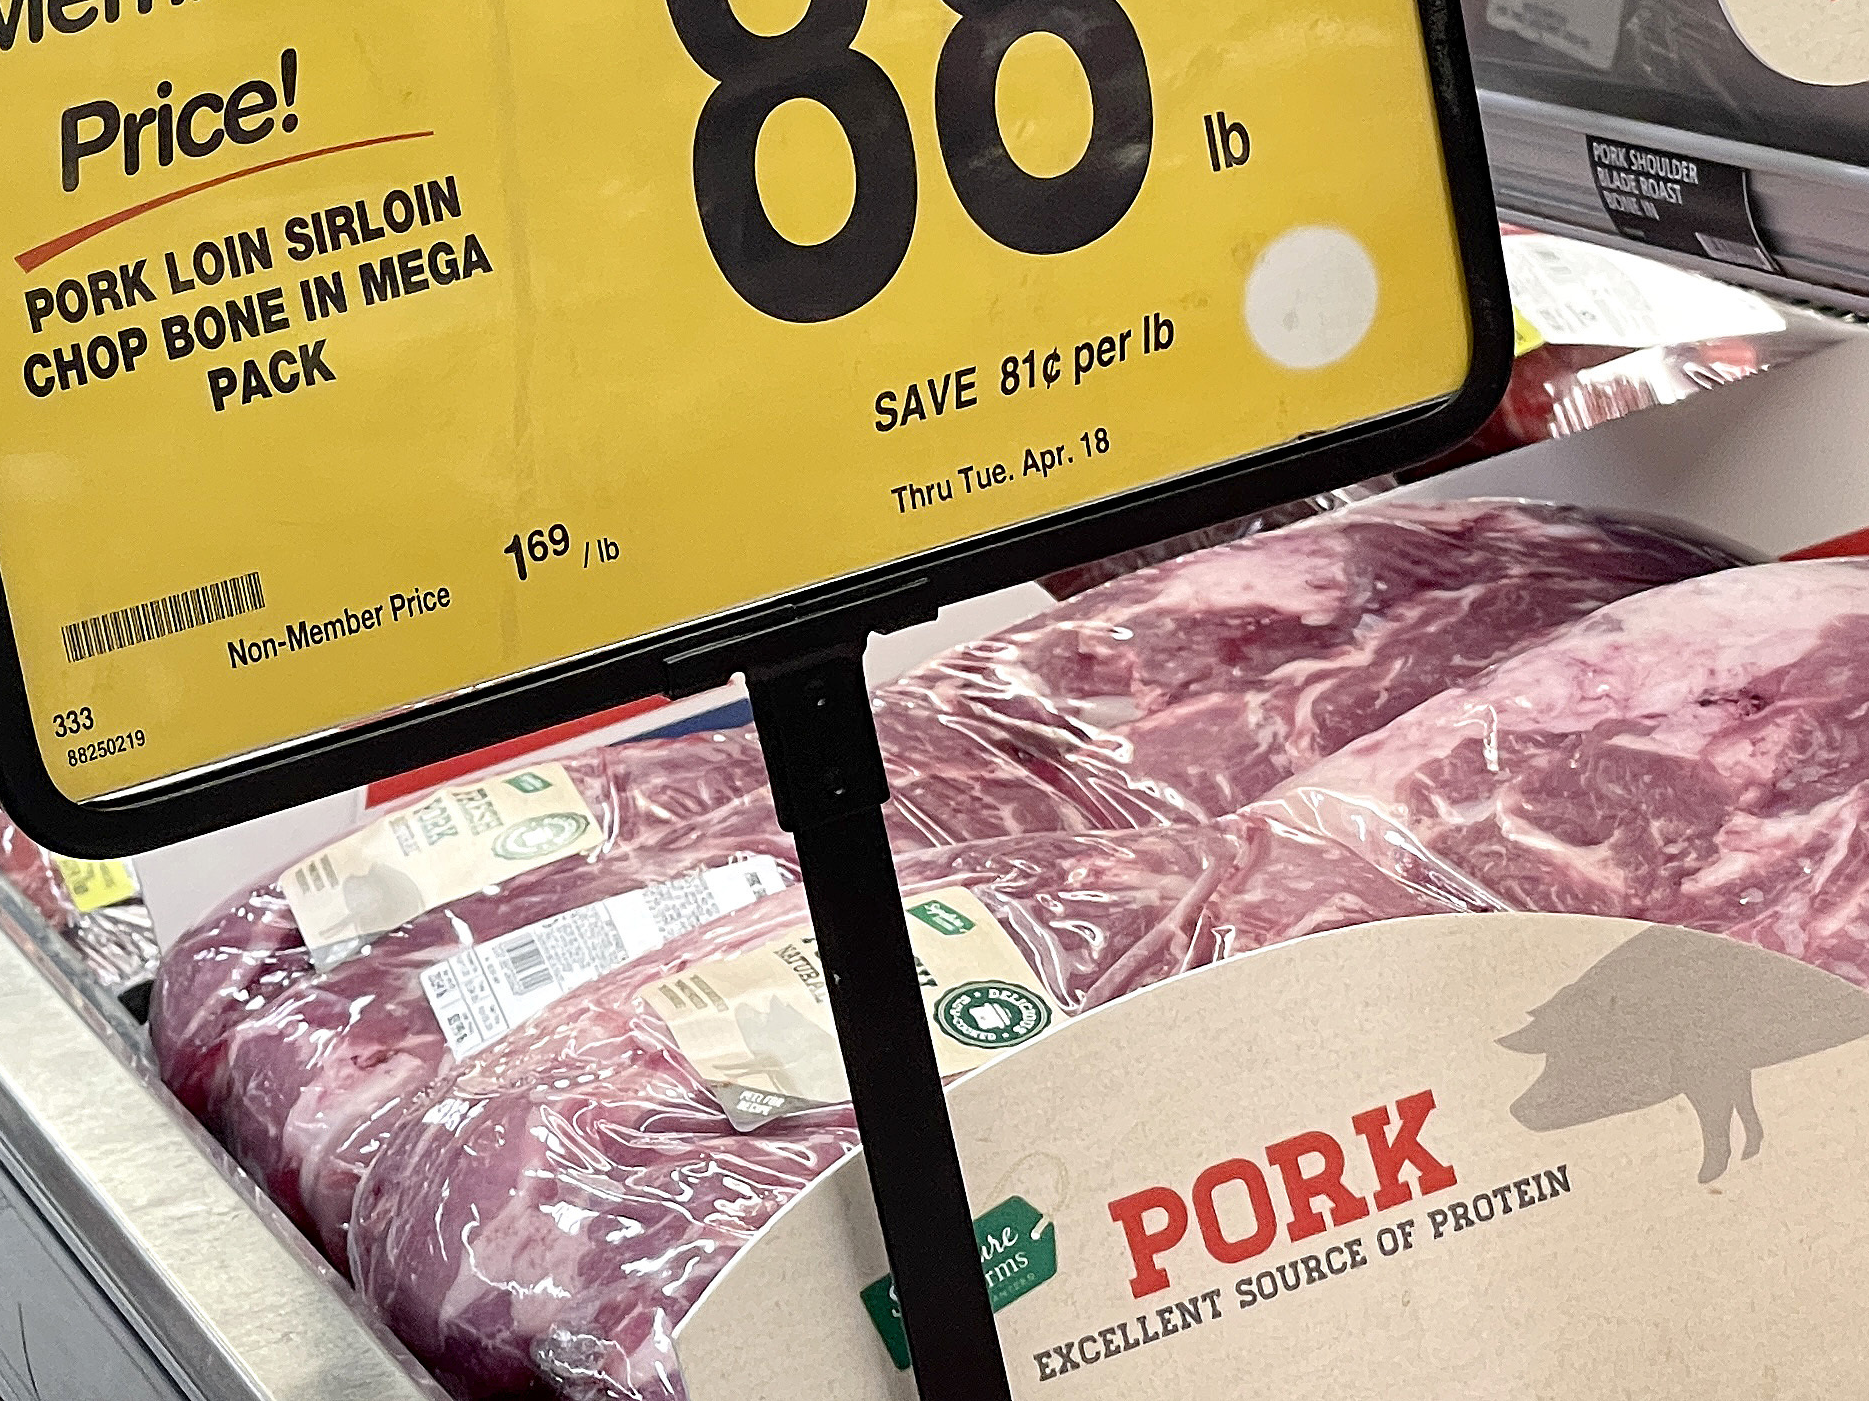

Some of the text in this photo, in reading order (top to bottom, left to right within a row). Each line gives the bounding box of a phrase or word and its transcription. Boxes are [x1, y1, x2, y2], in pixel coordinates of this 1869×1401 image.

[60, 48, 299, 192] Price!
[1203, 111, 1250, 173] lb
[1593, 142, 1699, 184] PORK SHOULDER
[1597, 166, 1682, 205] BLADE ROAST
[1603, 190, 1660, 220] BONE IN
[24, 175, 463, 333] PORK LOIN SIRLOIN
[23, 234, 493, 398] CHOP BONE IN MEGA
[208, 339, 336, 414] PACK
[874, 311, 1175, 434] SAVE 81¢ per lb
[891, 426, 1111, 516] Thru Tue. Apr. 18
[227, 602, 383, 669] Non-Member
[389, 584, 452, 623] Price
[596, 536, 620, 563] lb
[52, 705, 95, 739] 333
[67, 728, 146, 768] 88250219
[1108, 1089, 1458, 1299] PORK
[985, 1252, 1028, 1287] rms
[1034, 1163, 1573, 1384] EXCELLENT SOURCE OF PROTEIN
